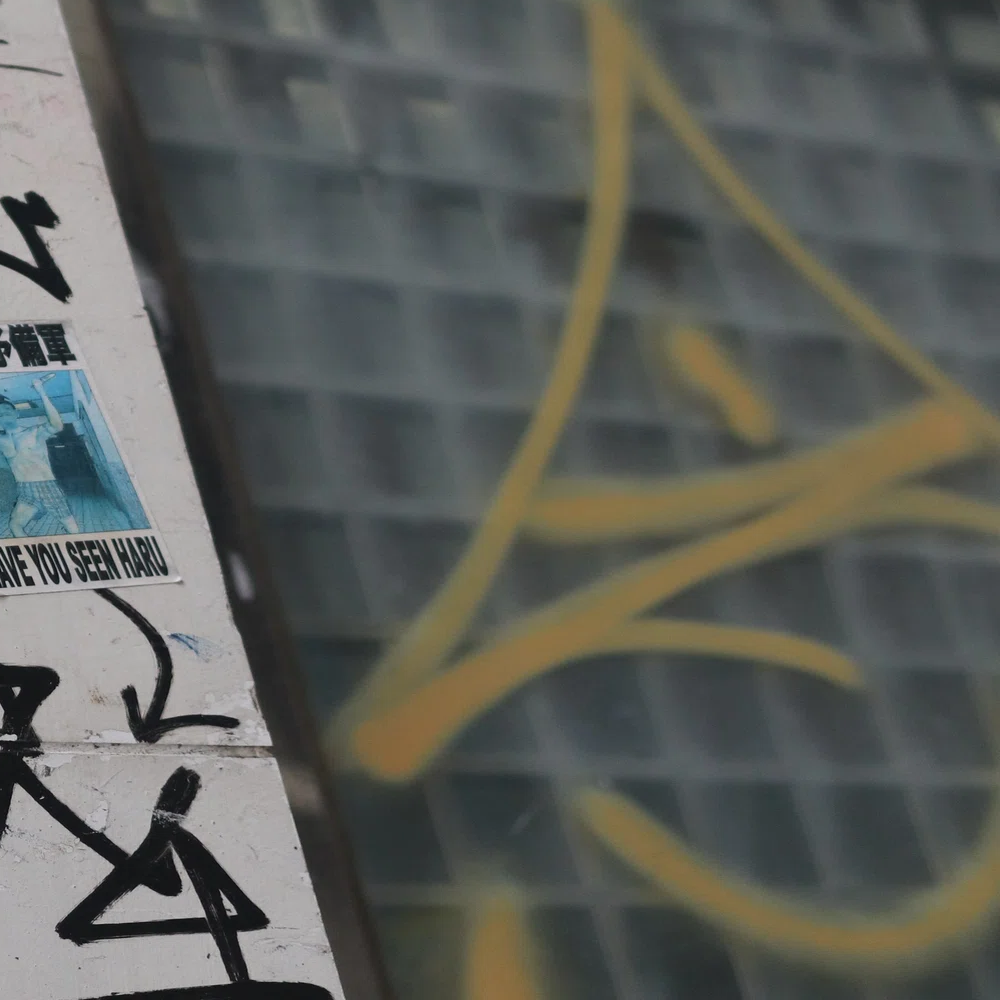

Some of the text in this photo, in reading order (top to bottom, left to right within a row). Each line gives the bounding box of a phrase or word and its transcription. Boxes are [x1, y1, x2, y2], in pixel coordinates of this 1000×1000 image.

[24, 541, 73, 585] YOU
[67, 538, 121, 582] SEEN
[110, 535, 169, 580] HARU
